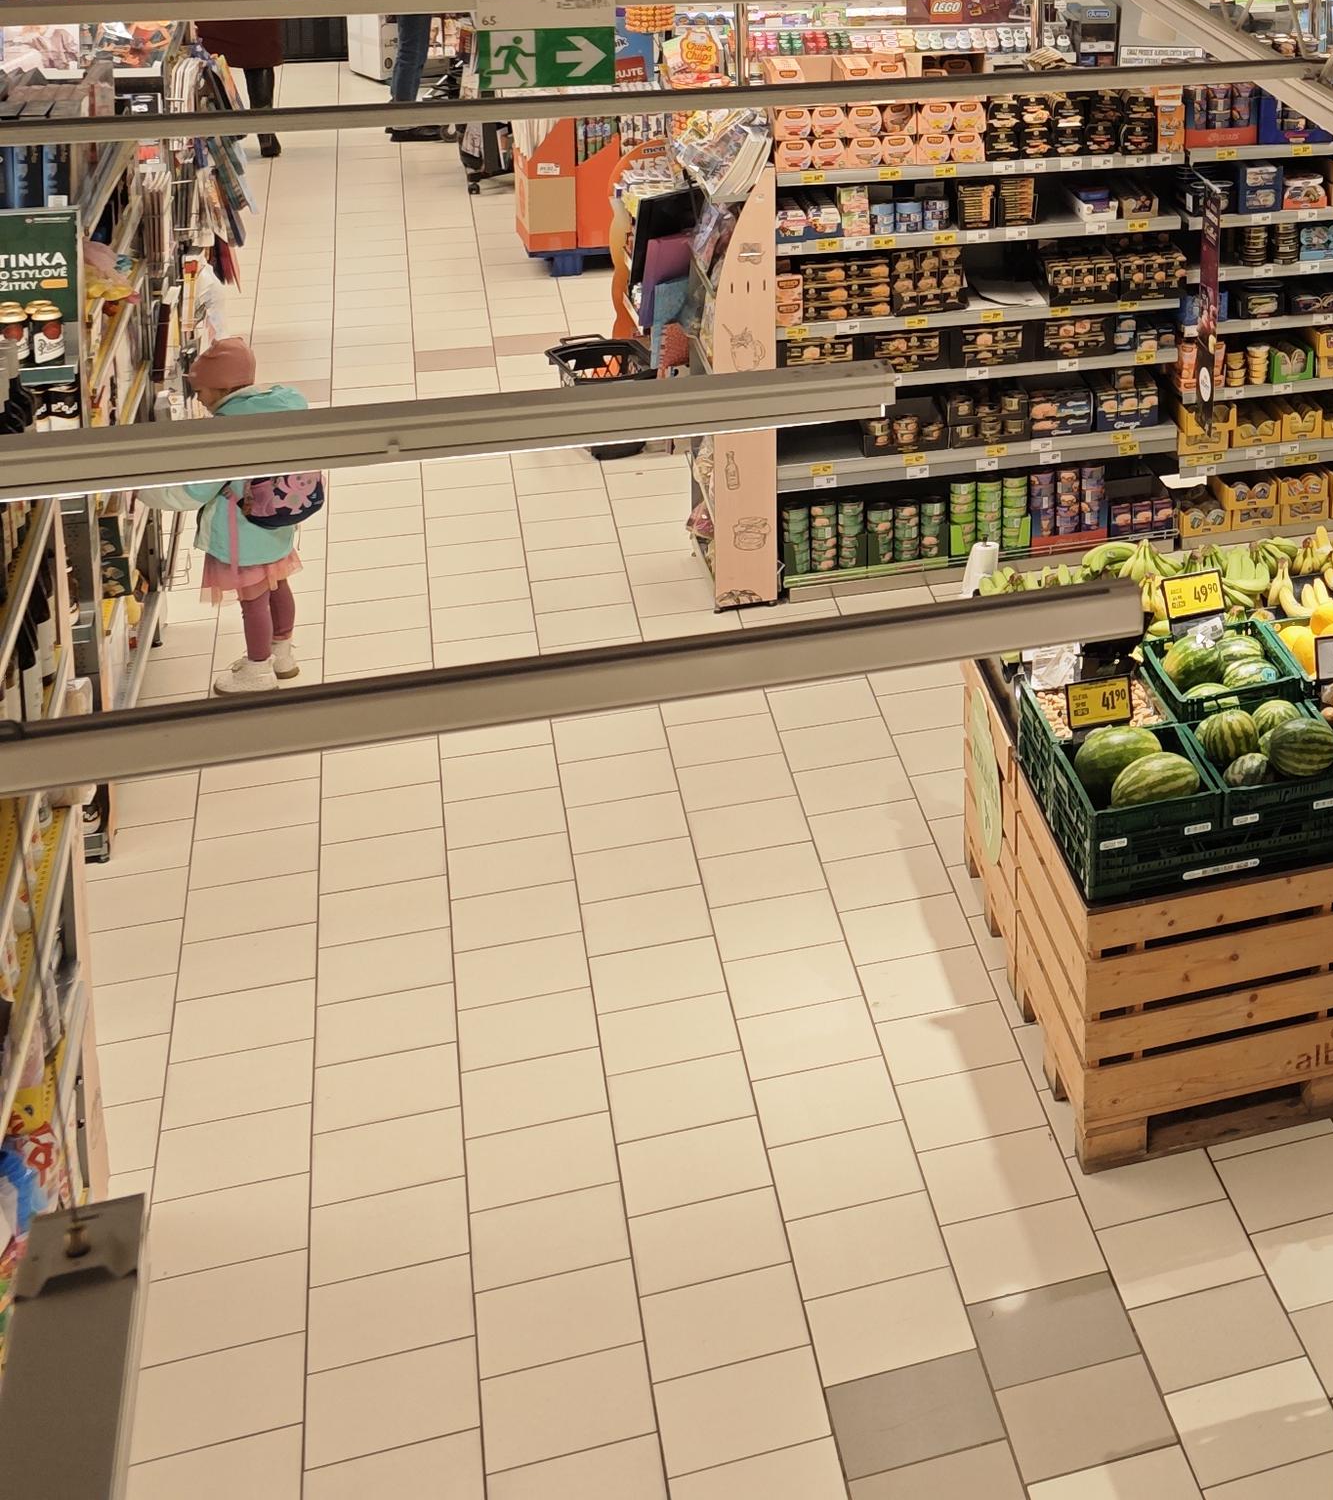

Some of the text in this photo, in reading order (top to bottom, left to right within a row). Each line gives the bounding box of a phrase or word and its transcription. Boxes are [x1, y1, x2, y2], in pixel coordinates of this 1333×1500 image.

[932, 0, 962, 14] LEGO
[481, 15, 497, 26] 65
[686, 41, 713, 52] Chupa
[685, 50, 712, 63] Chups
[12, 267, 68, 279] STYLOVÉ
[1193, 582, 1219, 604] 4990
[1101, 688, 1127, 710] 4190
